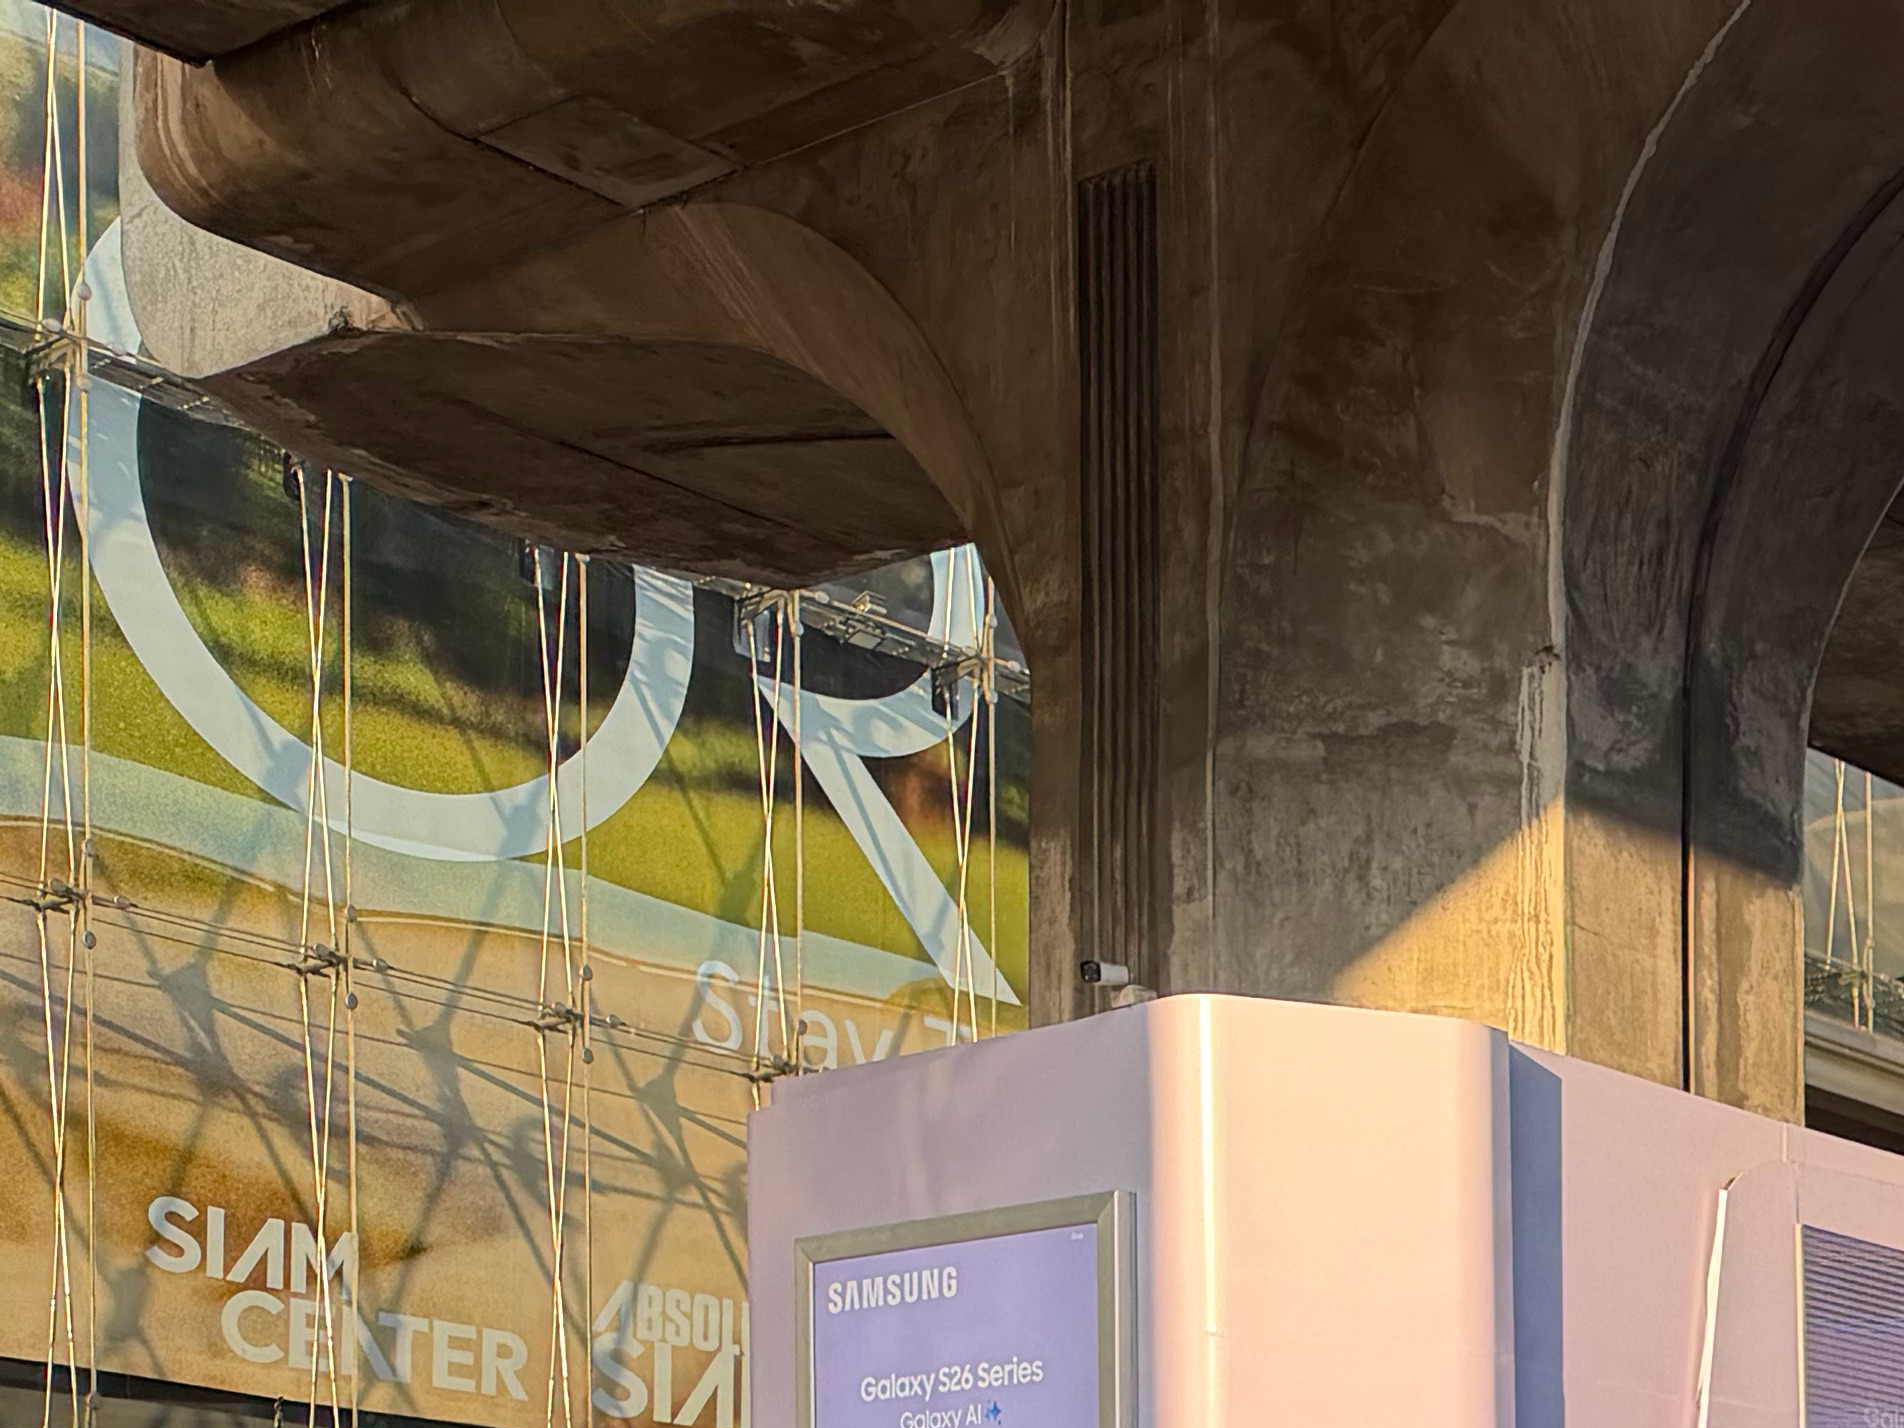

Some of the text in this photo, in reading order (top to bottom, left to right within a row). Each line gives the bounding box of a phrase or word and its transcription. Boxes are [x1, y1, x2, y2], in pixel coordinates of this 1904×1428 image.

[146, 1196, 358, 1293] SIAM
[828, 1266, 958, 1314] SAMSUNG
[222, 1290, 528, 1400] CENTER
[861, 1356, 1044, 1402] Galaxy S26 Series
[966, 1404, 982, 1425] AI
